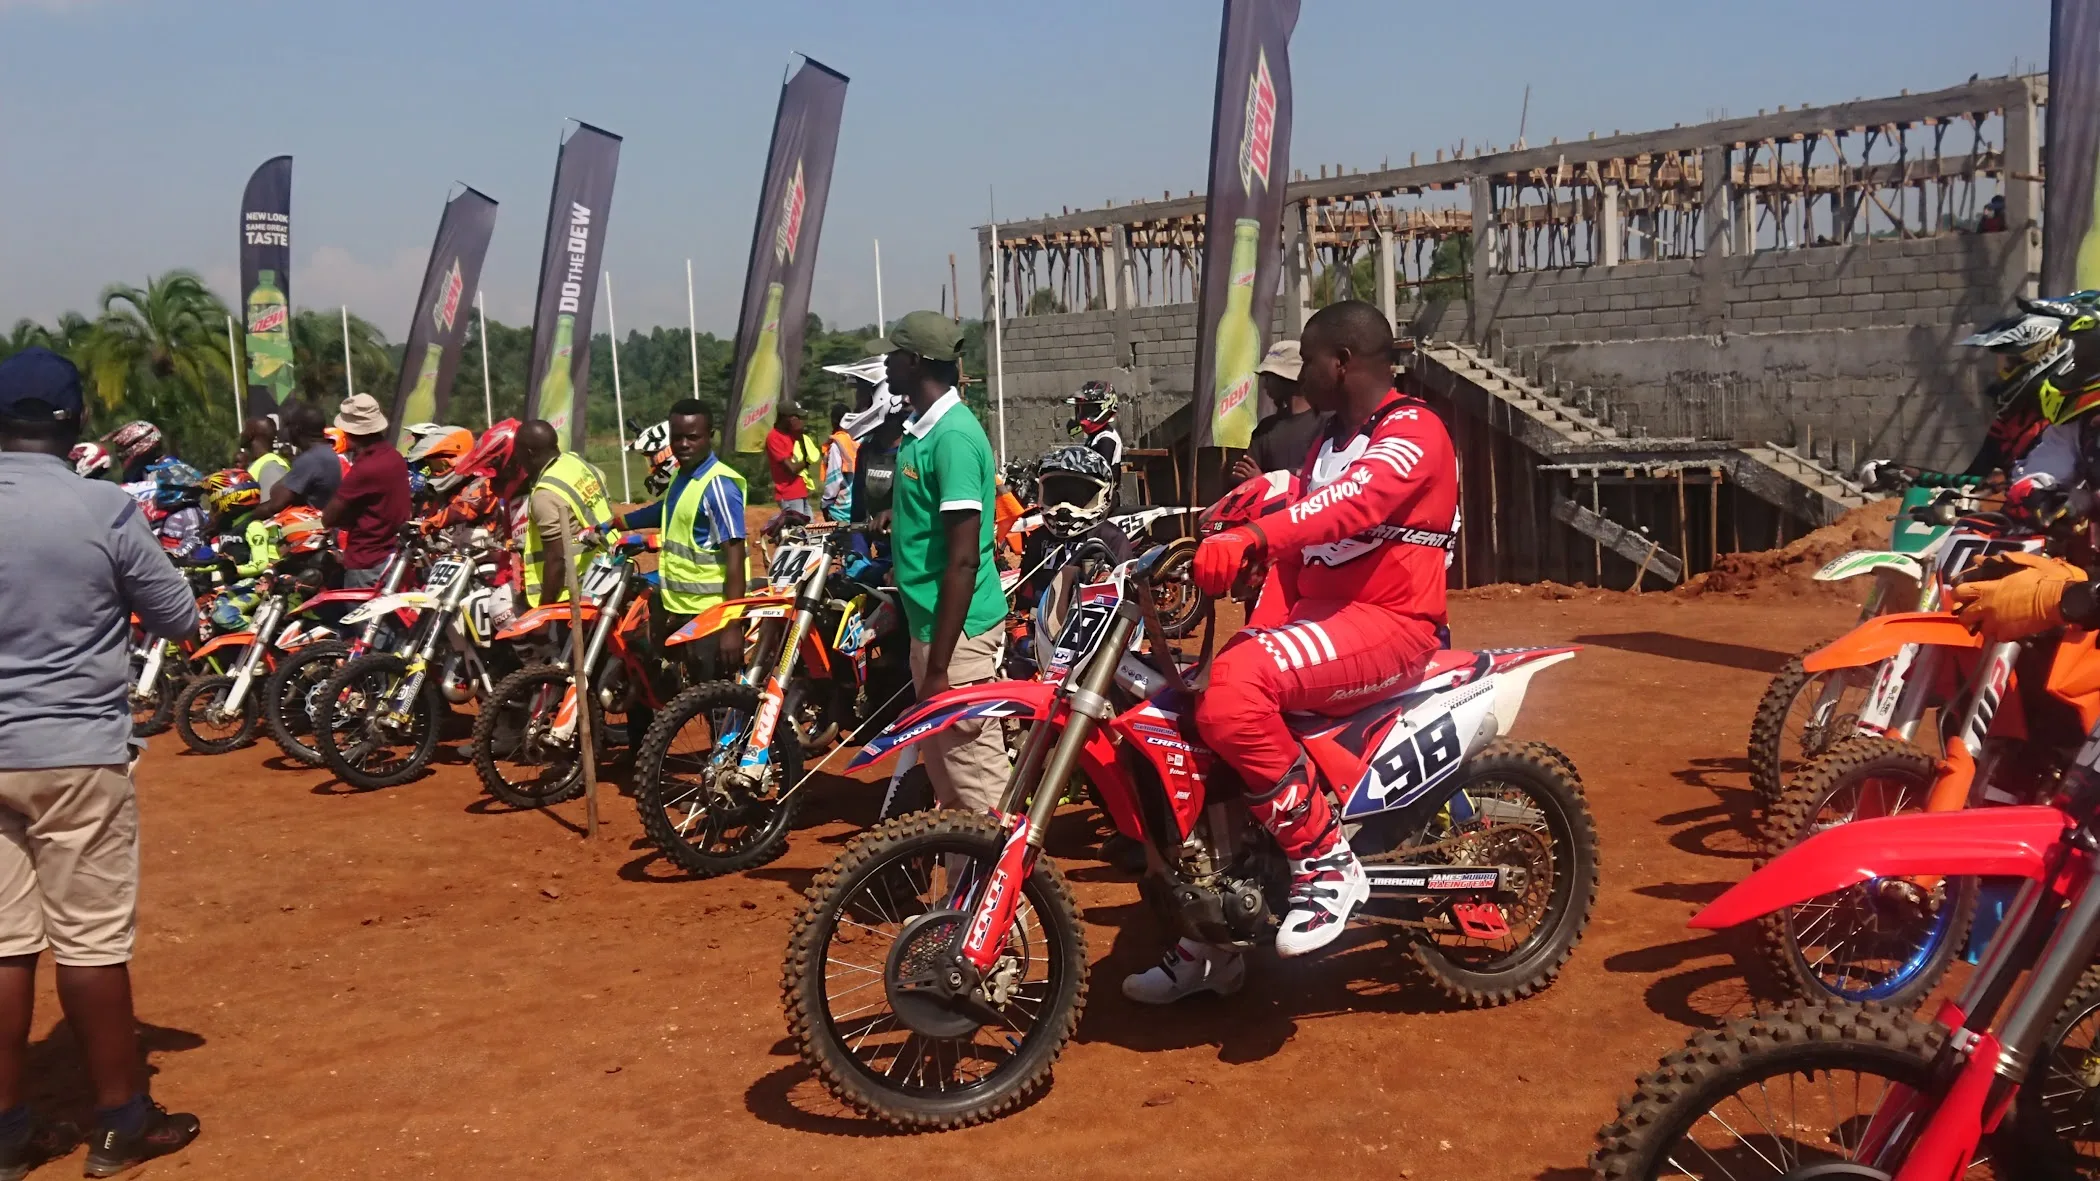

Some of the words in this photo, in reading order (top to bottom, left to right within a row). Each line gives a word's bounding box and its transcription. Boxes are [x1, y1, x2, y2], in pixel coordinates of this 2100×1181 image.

[245, 223, 266, 231] SAME
[266, 224, 288, 232] GREAT
[246, 211, 266, 221] NEW
[267, 212, 288, 223] LOOK
[567, 201, 591, 254] DEW
[245, 232, 288, 246] TASTE
[867, 468, 893, 479] THOR
[768, 550, 813, 584] 44
[1450, 684, 1494, 711] KIGGUNDU
[757, 694, 781, 746] KTM
[893, 722, 932, 746] HONDA
[1371, 711, 1462, 807] 98
[969, 868, 1008, 950] HONDA
